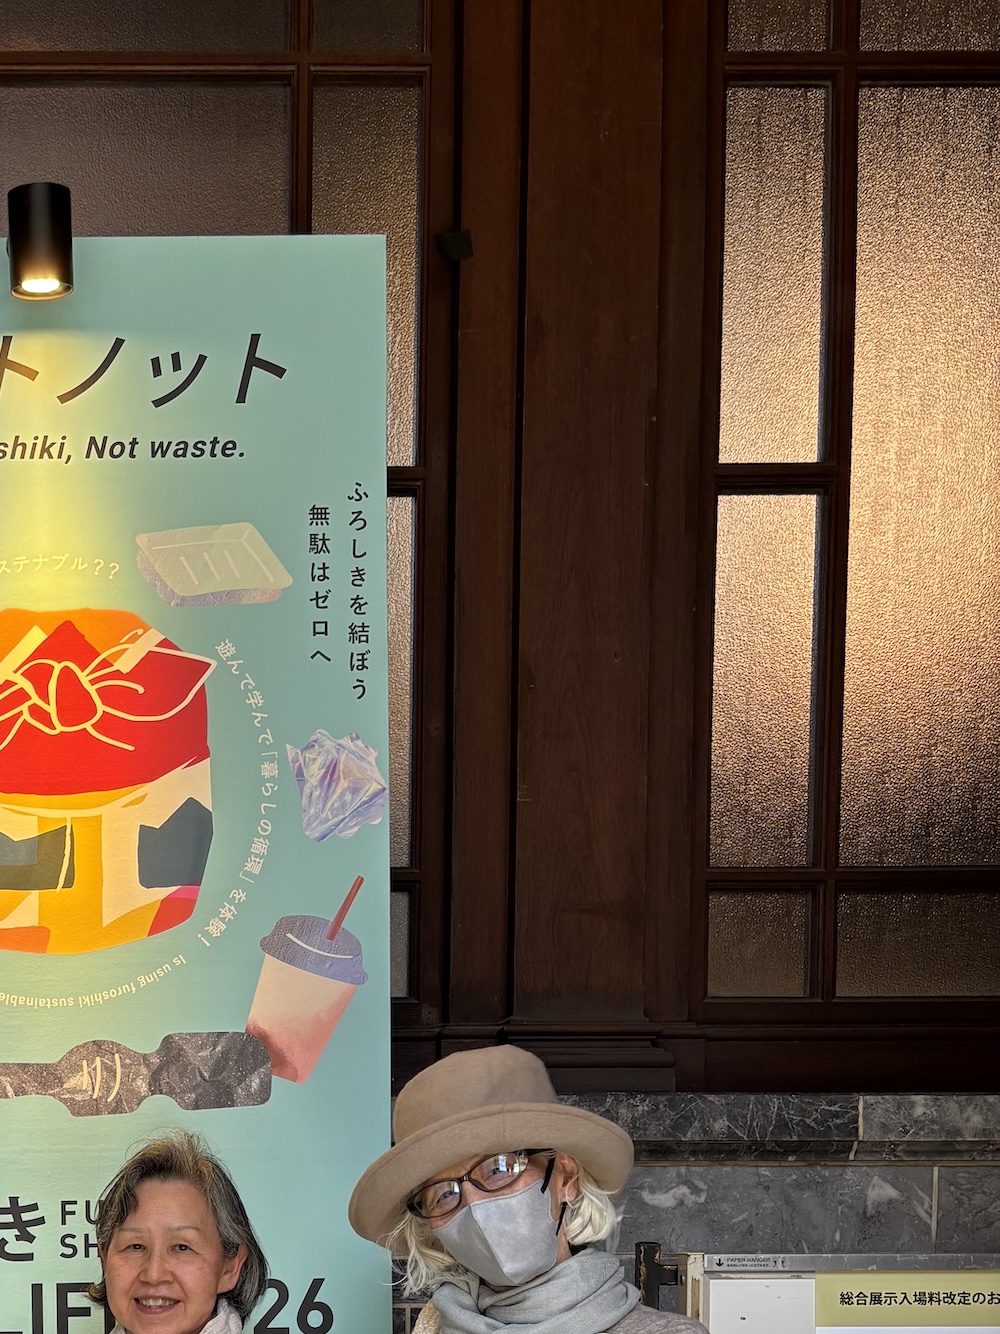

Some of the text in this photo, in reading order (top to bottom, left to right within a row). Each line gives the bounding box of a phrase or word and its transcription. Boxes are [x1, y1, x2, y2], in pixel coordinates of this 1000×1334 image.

[85, 435, 141, 461] Not
[149, 435, 245, 460] waste.
[308, 504, 332, 663] 無駄はゼロへ
[347, 482, 371, 699] ふろしきを結ぼう
[172, 954, 187, 966] Is
[136, 963, 171, 988] using
[79, 982, 136, 1008] furoshiki
[839, 1291, 1000, 1306] 総合展示入場料改定のお
